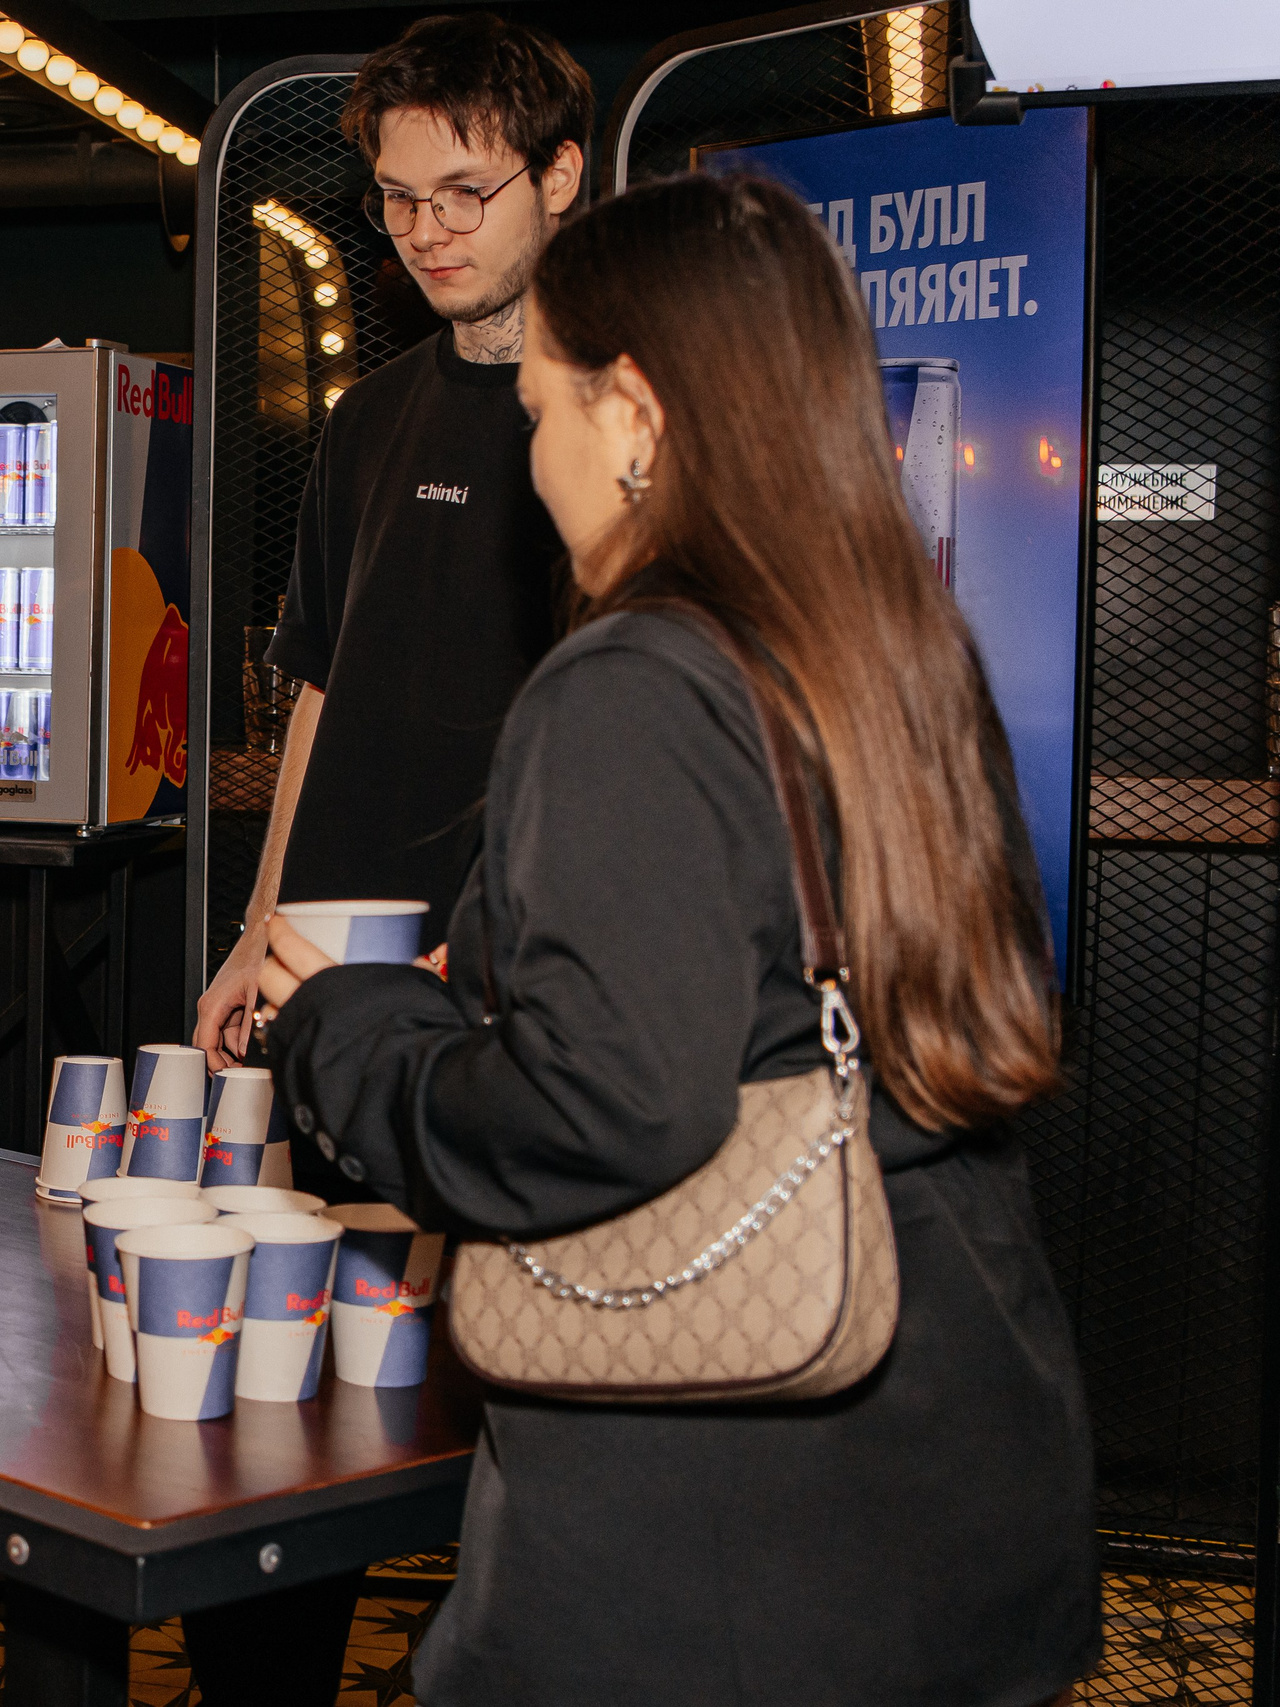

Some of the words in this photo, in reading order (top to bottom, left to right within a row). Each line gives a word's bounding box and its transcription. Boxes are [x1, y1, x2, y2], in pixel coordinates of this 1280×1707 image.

[870, 181, 986, 254] БУЛЛ
[860, 254, 1038, 328] ЛЯЯЯЕТ.
[117, 363, 155, 418] Red
[158, 372, 193, 425] Bull
[9, 750, 38, 767] Bull
[66, 1134, 96, 1149] Bull
[98, 1134, 124, 1149] Red
[140, 1124, 169, 1142] Red
[207, 1148, 233, 1166] Red
[355, 1278, 396, 1298] Red
[398, 1278, 431, 1298] Bull
[286, 1289, 325, 1311] Red
[177, 1308, 219, 1328] Red
